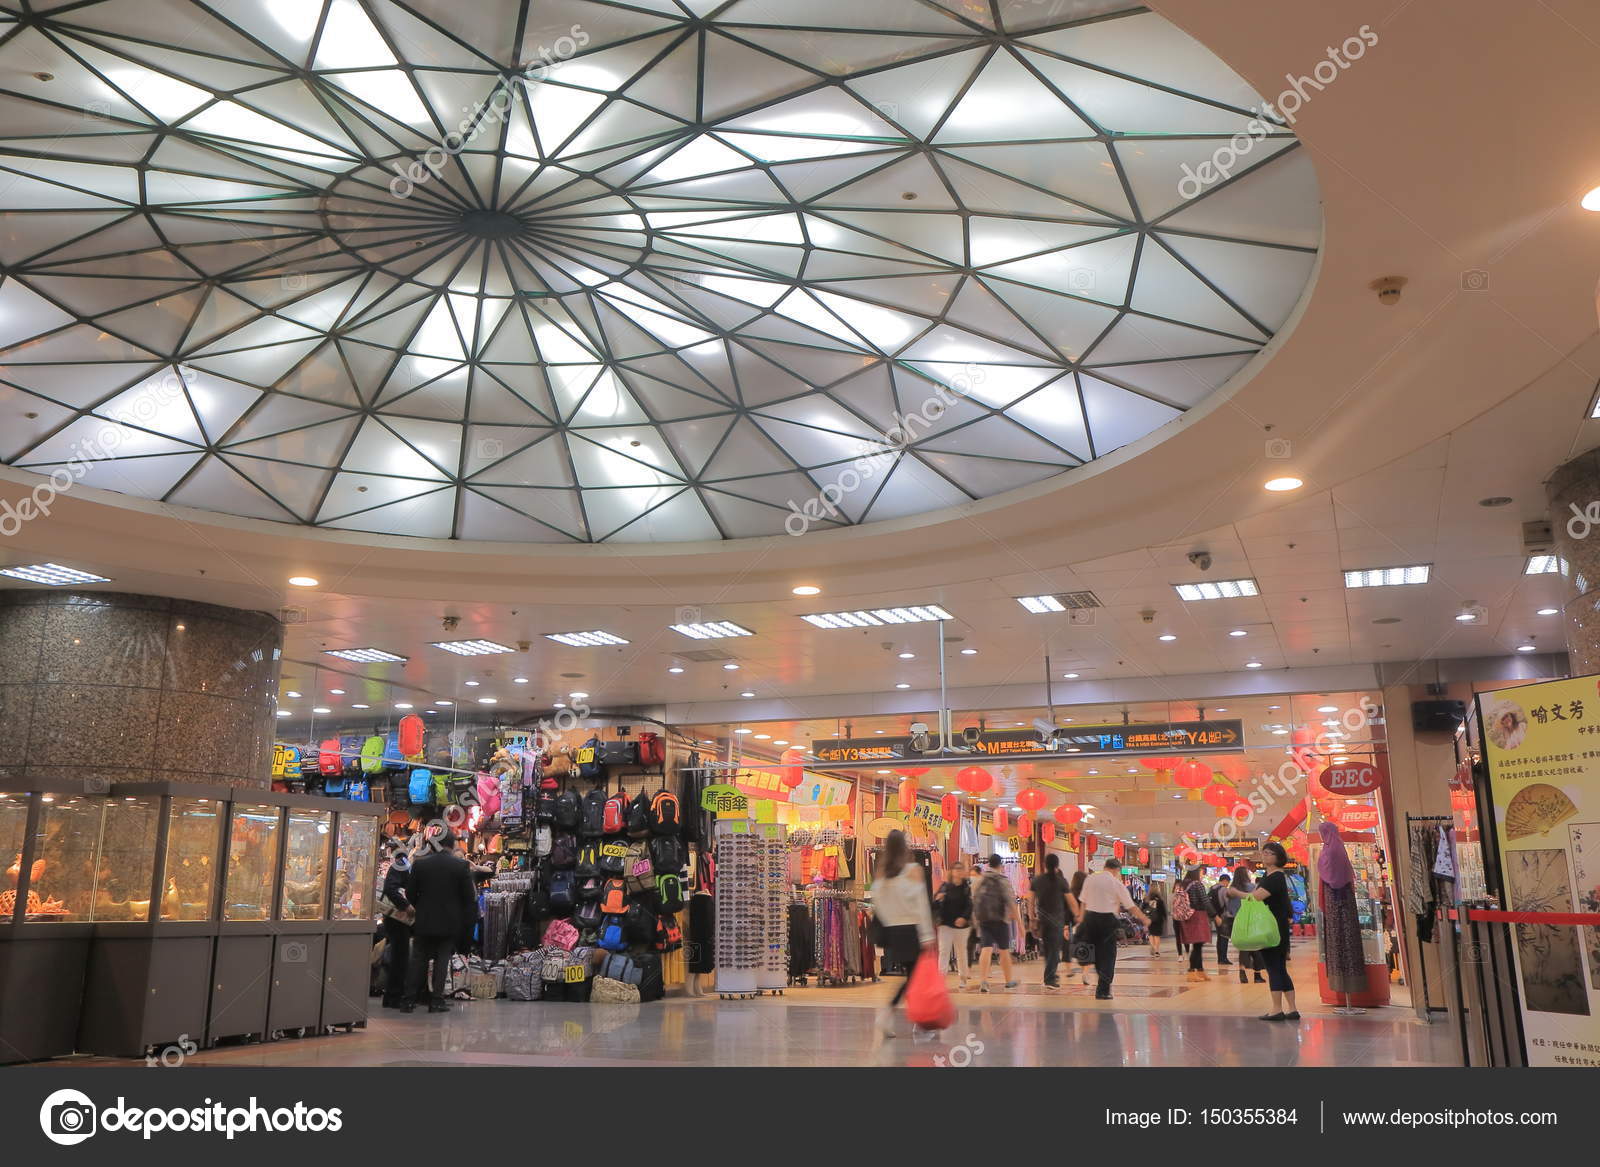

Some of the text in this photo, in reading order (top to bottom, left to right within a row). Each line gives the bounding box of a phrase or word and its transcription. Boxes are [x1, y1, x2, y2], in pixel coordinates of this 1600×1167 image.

[1531, 700, 1584, 724] 喻文芳
[1187, 731, 1208, 745] Y4
[842, 748, 858, 761] Y3
[987, 742, 1000, 754] M
[1330, 768, 1373, 788] EEC
[717, 796, 748, 811] 雨傘
[1009, 838, 1019, 851] 98
[1022, 854, 1033, 865] 98
[567, 966, 584, 981] 100
